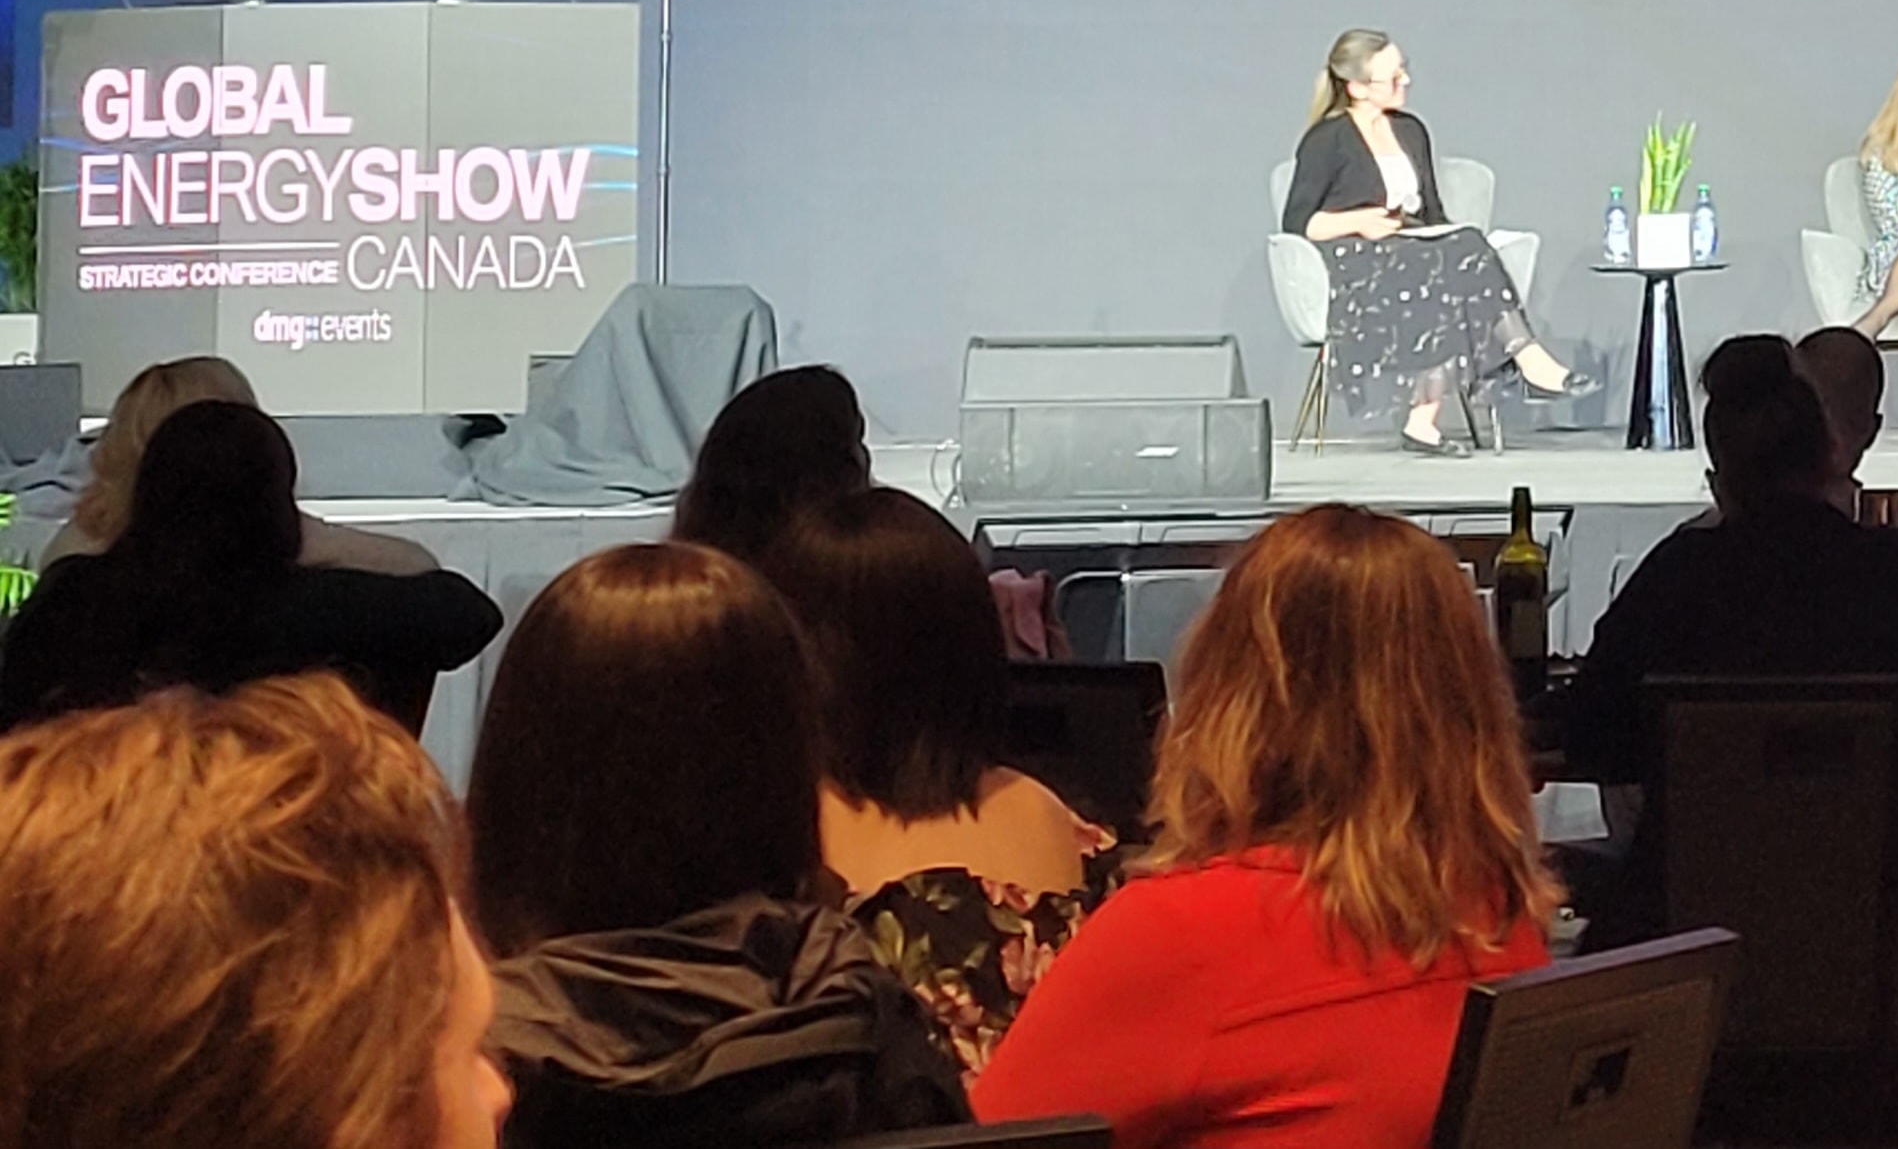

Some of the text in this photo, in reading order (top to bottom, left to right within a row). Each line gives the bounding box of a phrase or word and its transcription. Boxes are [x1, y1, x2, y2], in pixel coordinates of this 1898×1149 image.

[83, 64, 353, 141] GLOBAL
[79, 259, 340, 289] STRATEGIC CONFERENCE
[346, 235, 587, 291] CANADA
